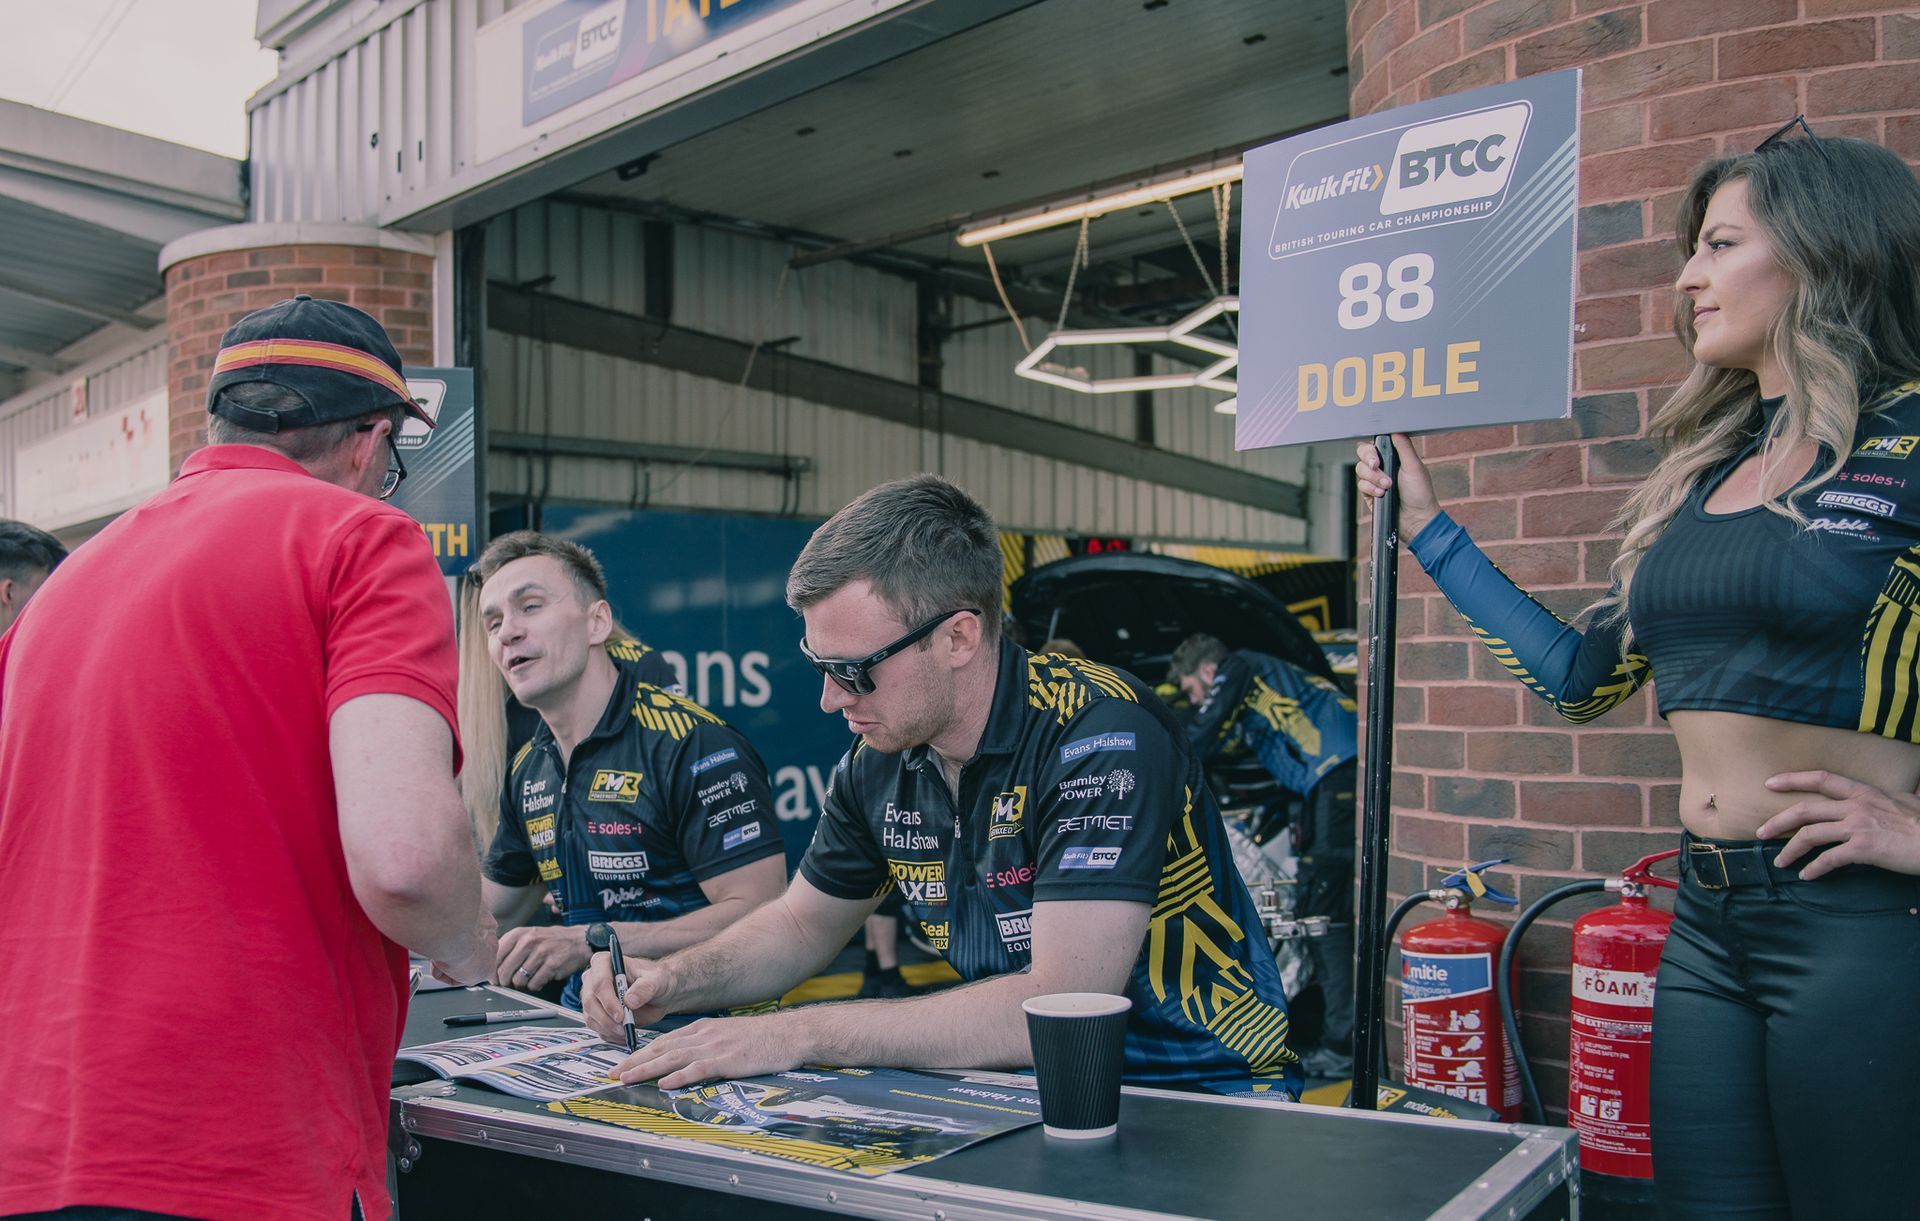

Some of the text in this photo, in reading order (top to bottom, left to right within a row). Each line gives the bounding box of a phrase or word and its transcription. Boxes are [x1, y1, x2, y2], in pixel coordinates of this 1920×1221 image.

[581, 16, 617, 51] BTCC
[1400, 134, 1506, 189] BTCC
[1275, 201, 1493, 253] BRITISH TOURING CAR CHAMPIONSHIP
[1338, 253, 1434, 330] 88
[1297, 341, 1481, 412] DOBLE
[1861, 438, 1914, 451] PMR
[1852, 473, 1906, 487] sales-i
[1823, 494, 1889, 514] BRIGGS
[420, 524, 468, 556] TH
[1064, 737, 1132, 759] Evans Halshaw
[524, 780, 546, 796] Evans
[594, 773, 638, 791] PMR
[698, 779, 730, 798] Bramley
[1059, 775, 1107, 790] Bramley
[523, 795, 554, 813] Halshaw
[702, 788, 732, 806] POWER
[885, 803, 922, 825] Evans
[528, 818, 552, 834] POWER
[599, 822, 642, 835] sales-i
[531, 830, 554, 846] MAXED
[883, 827, 939, 850] Halshaw
[592, 856, 643, 869] BRIGGS
[1092, 852, 1118, 860] BTCC
[594, 872, 646, 880] EQUIPMENT
[889, 862, 943, 882] POWER
[1410, 964, 1449, 981] mitie
[1585, 977, 1637, 997] FOAM
